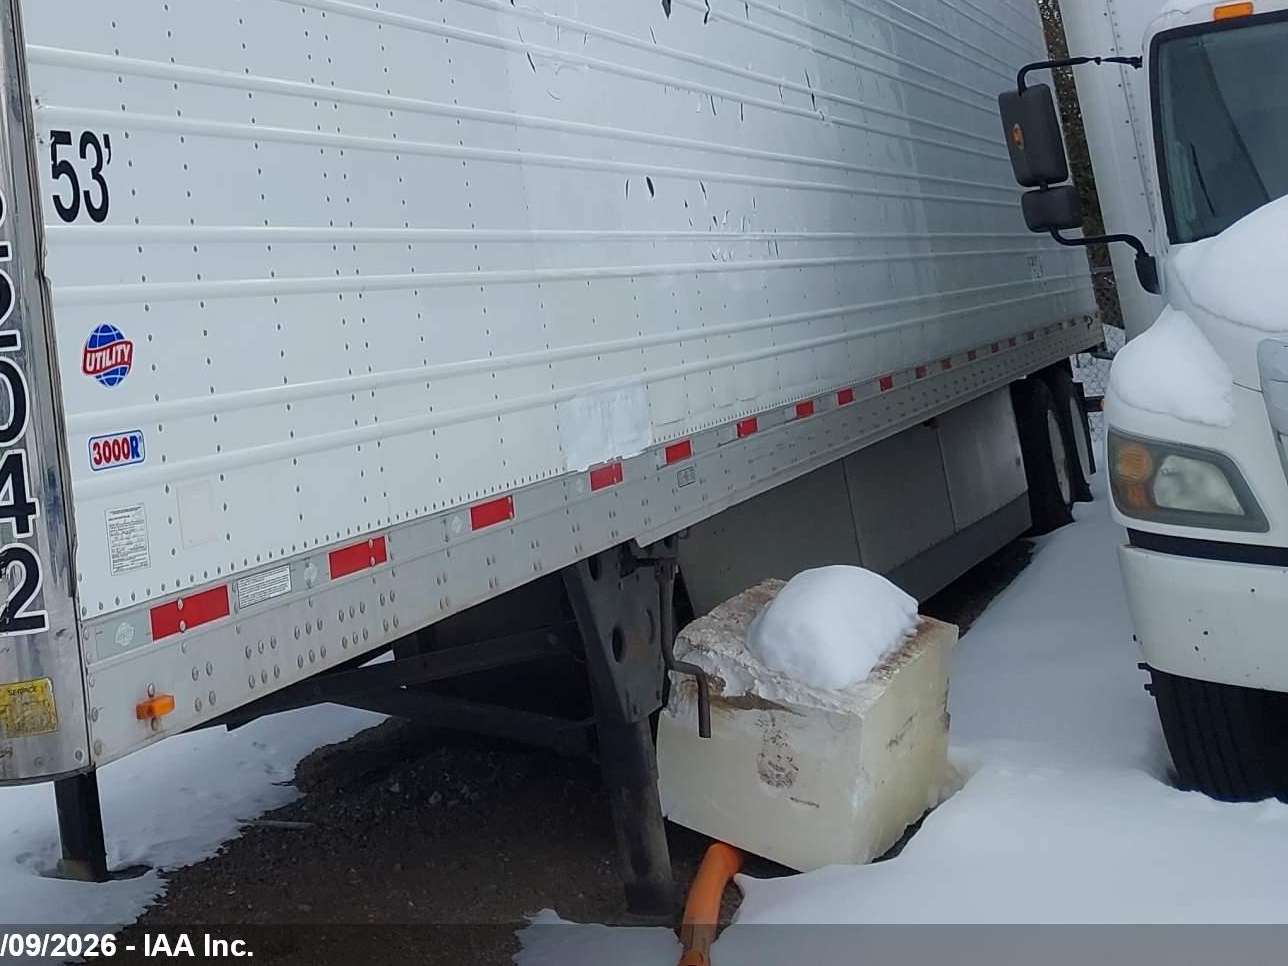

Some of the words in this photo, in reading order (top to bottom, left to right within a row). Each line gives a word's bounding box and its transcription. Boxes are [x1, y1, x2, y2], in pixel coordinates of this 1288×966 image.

[49, 129, 112, 223] 53'
[86, 344, 131, 372] UTILITY
[92, 435, 141, 466] 3000R
